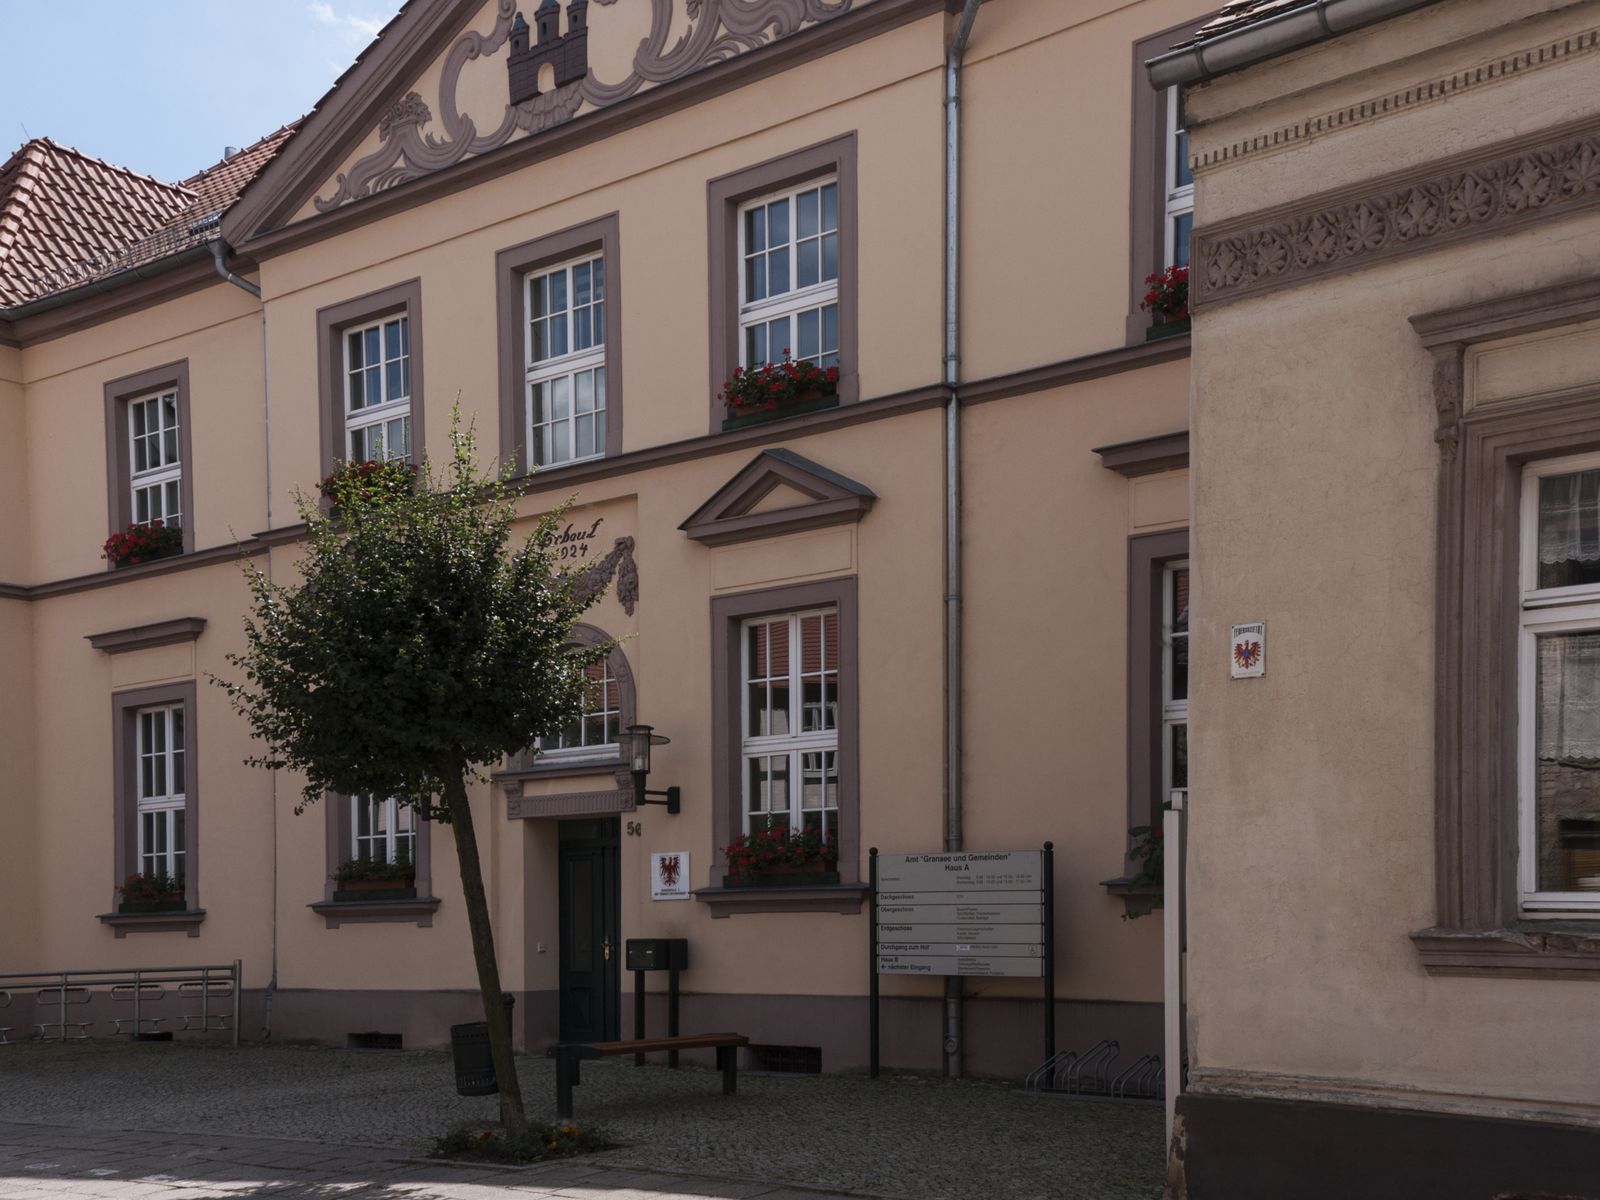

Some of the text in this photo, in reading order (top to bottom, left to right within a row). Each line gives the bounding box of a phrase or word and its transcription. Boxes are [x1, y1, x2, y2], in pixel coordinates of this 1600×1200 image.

[556, 542, 588, 560] 924
[920, 855, 952, 863] "Gransee
[953, 854, 967, 862] und
[967, 853, 1011, 862] Gemeinden"
[910, 964, 931, 972] Eingang
